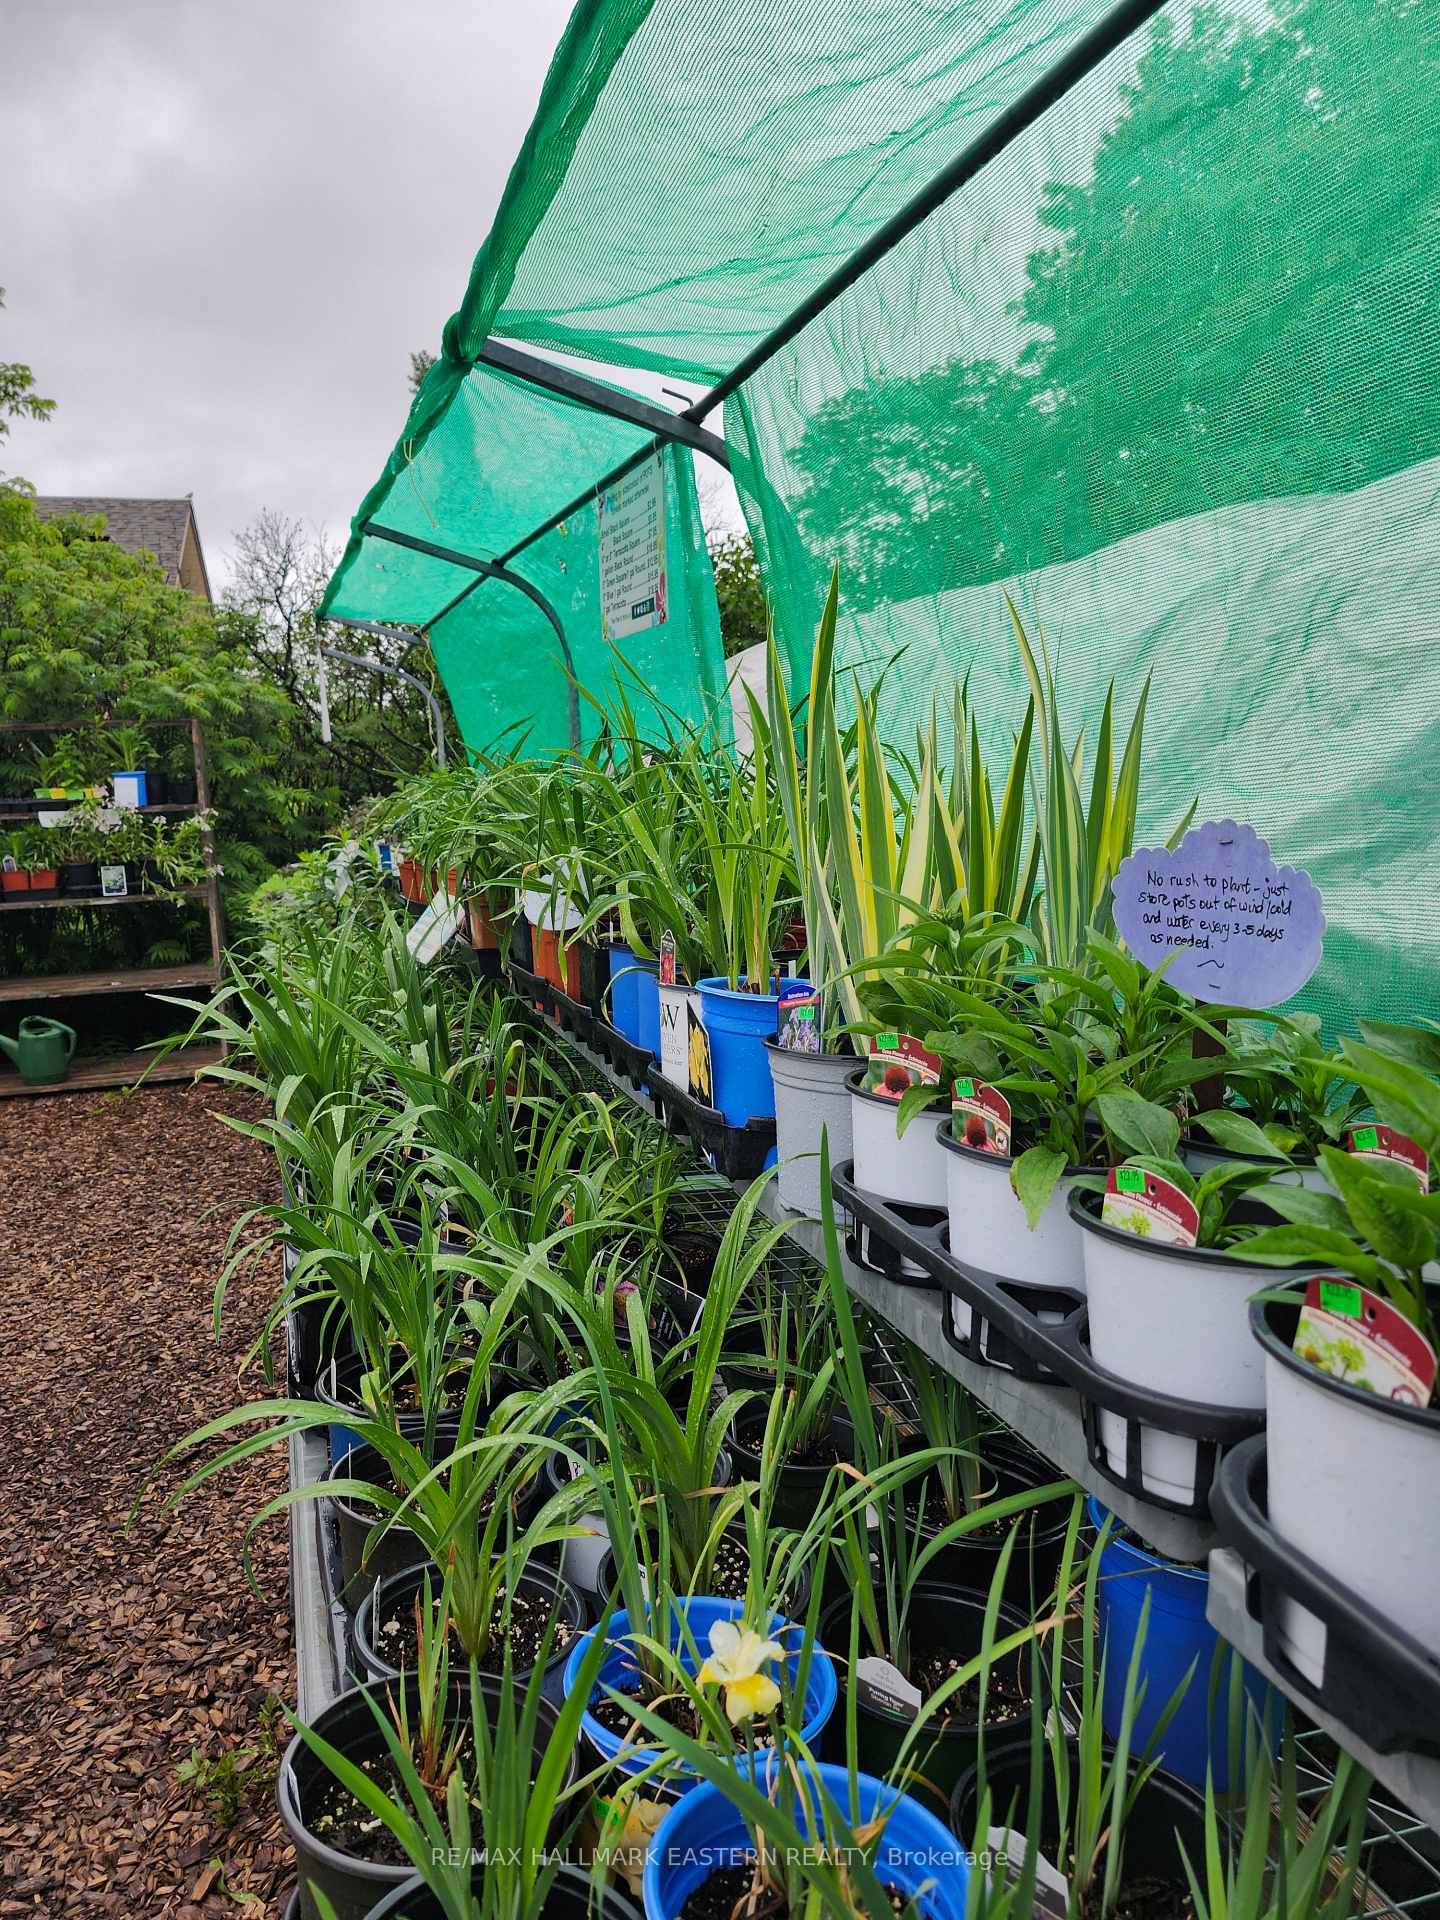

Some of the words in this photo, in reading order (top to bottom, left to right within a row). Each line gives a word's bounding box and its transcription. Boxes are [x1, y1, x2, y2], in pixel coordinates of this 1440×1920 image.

[1146, 872, 1164, 887] No
[1170, 873, 1199, 888] rush
[1203, 875, 1217, 888] to
[1222, 877, 1251, 895] plant
[1262, 878, 1289, 899] just
[1138, 892, 1170, 906] store
[1173, 895, 1196, 912] pots
[1199, 900, 1220, 910] out
[1224, 899, 1237, 911] of
[1142, 912, 1162, 924] and
[1167, 915, 1195, 929] water
[1199, 920, 1230, 943] every
[1256, 925, 1284, 943] days
[1151, 932, 1165, 944] as
[1166, 934, 1214, 950] needed.
